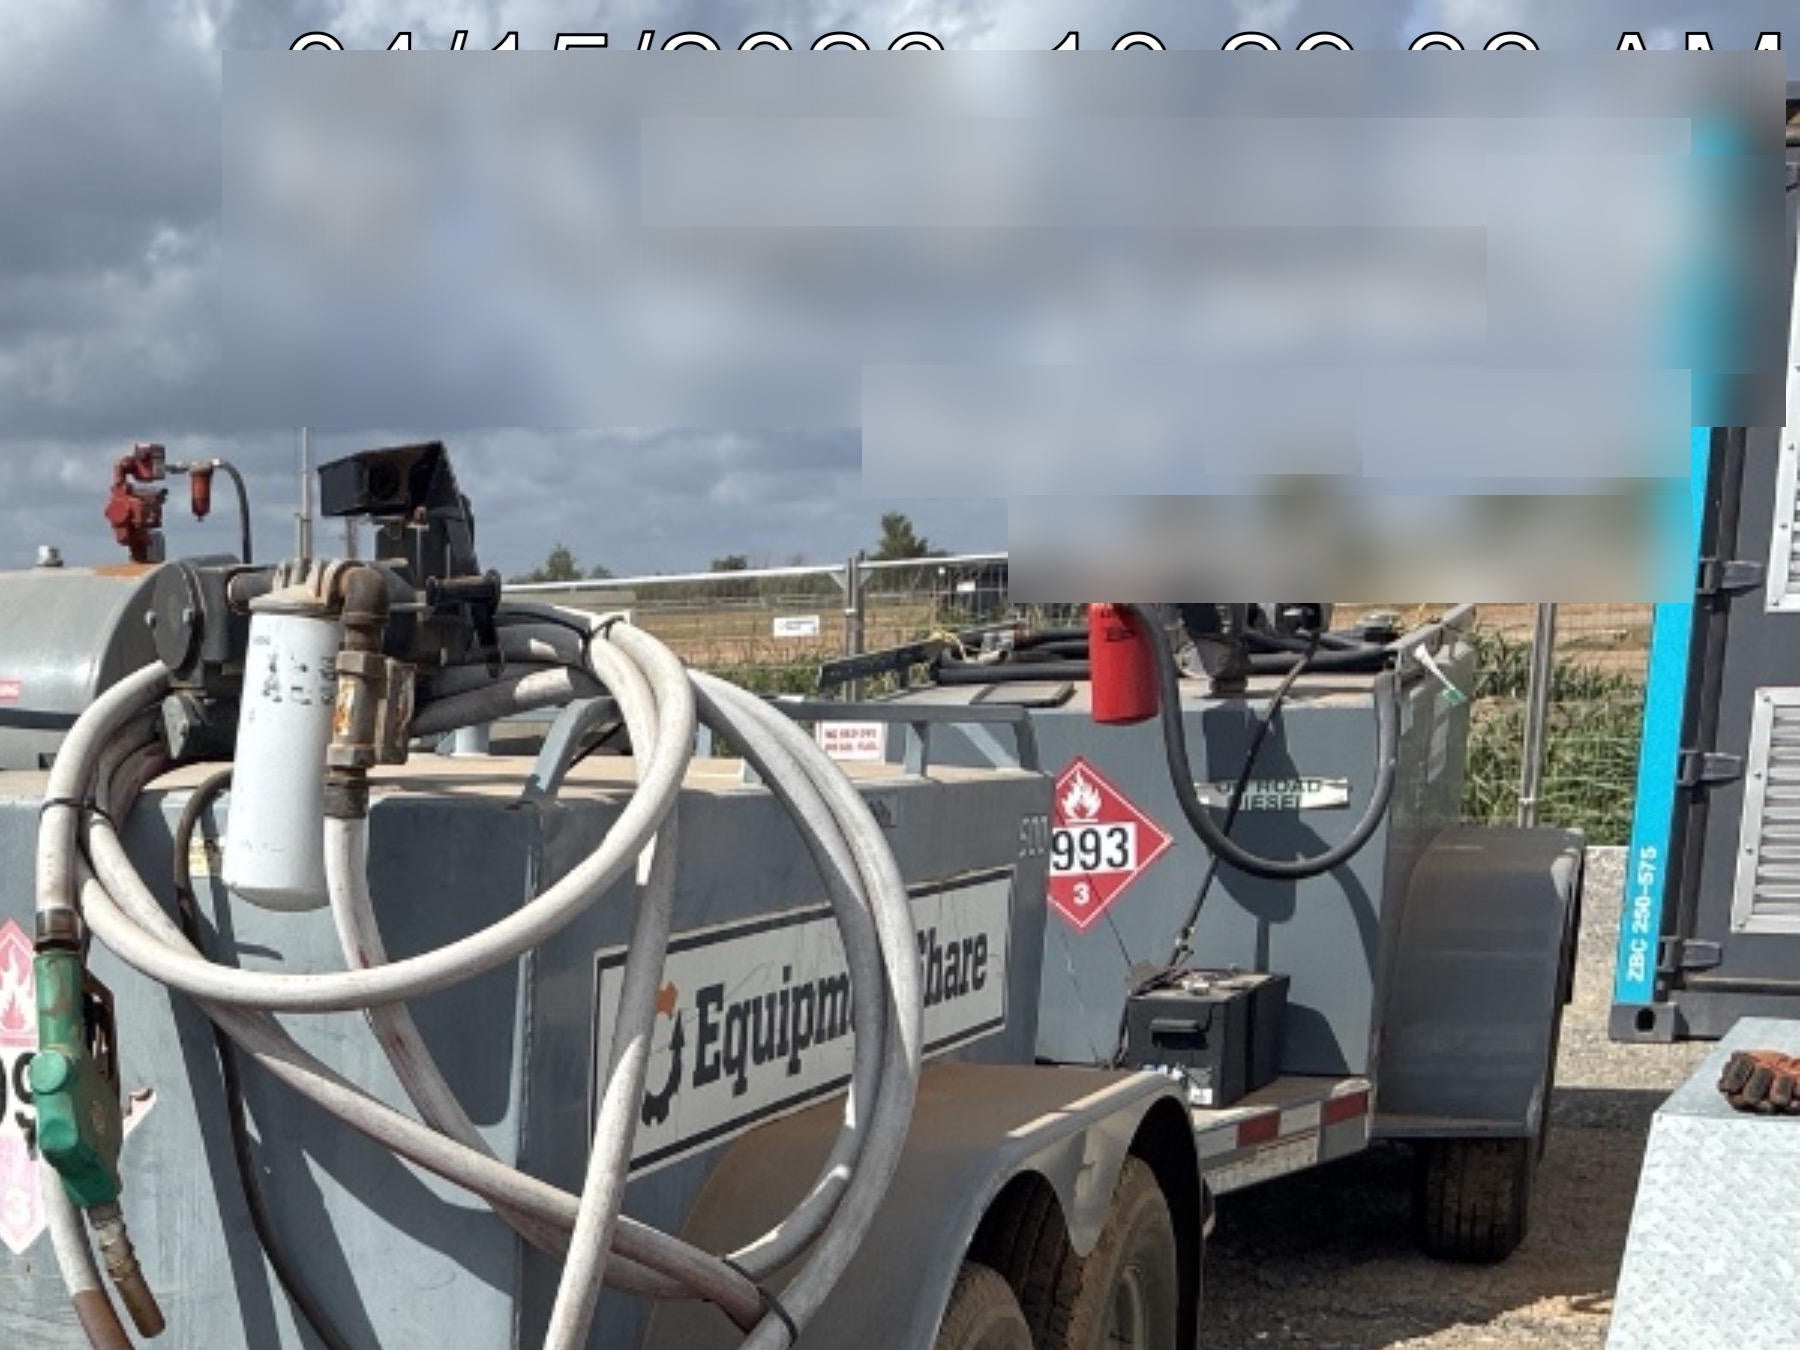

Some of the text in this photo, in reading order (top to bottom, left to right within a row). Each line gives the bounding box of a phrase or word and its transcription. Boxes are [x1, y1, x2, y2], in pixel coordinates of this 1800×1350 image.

[1052, 827, 1129, 871] 993
[1072, 881, 1091, 906] 3
[1626, 938, 1649, 982] ZBC
